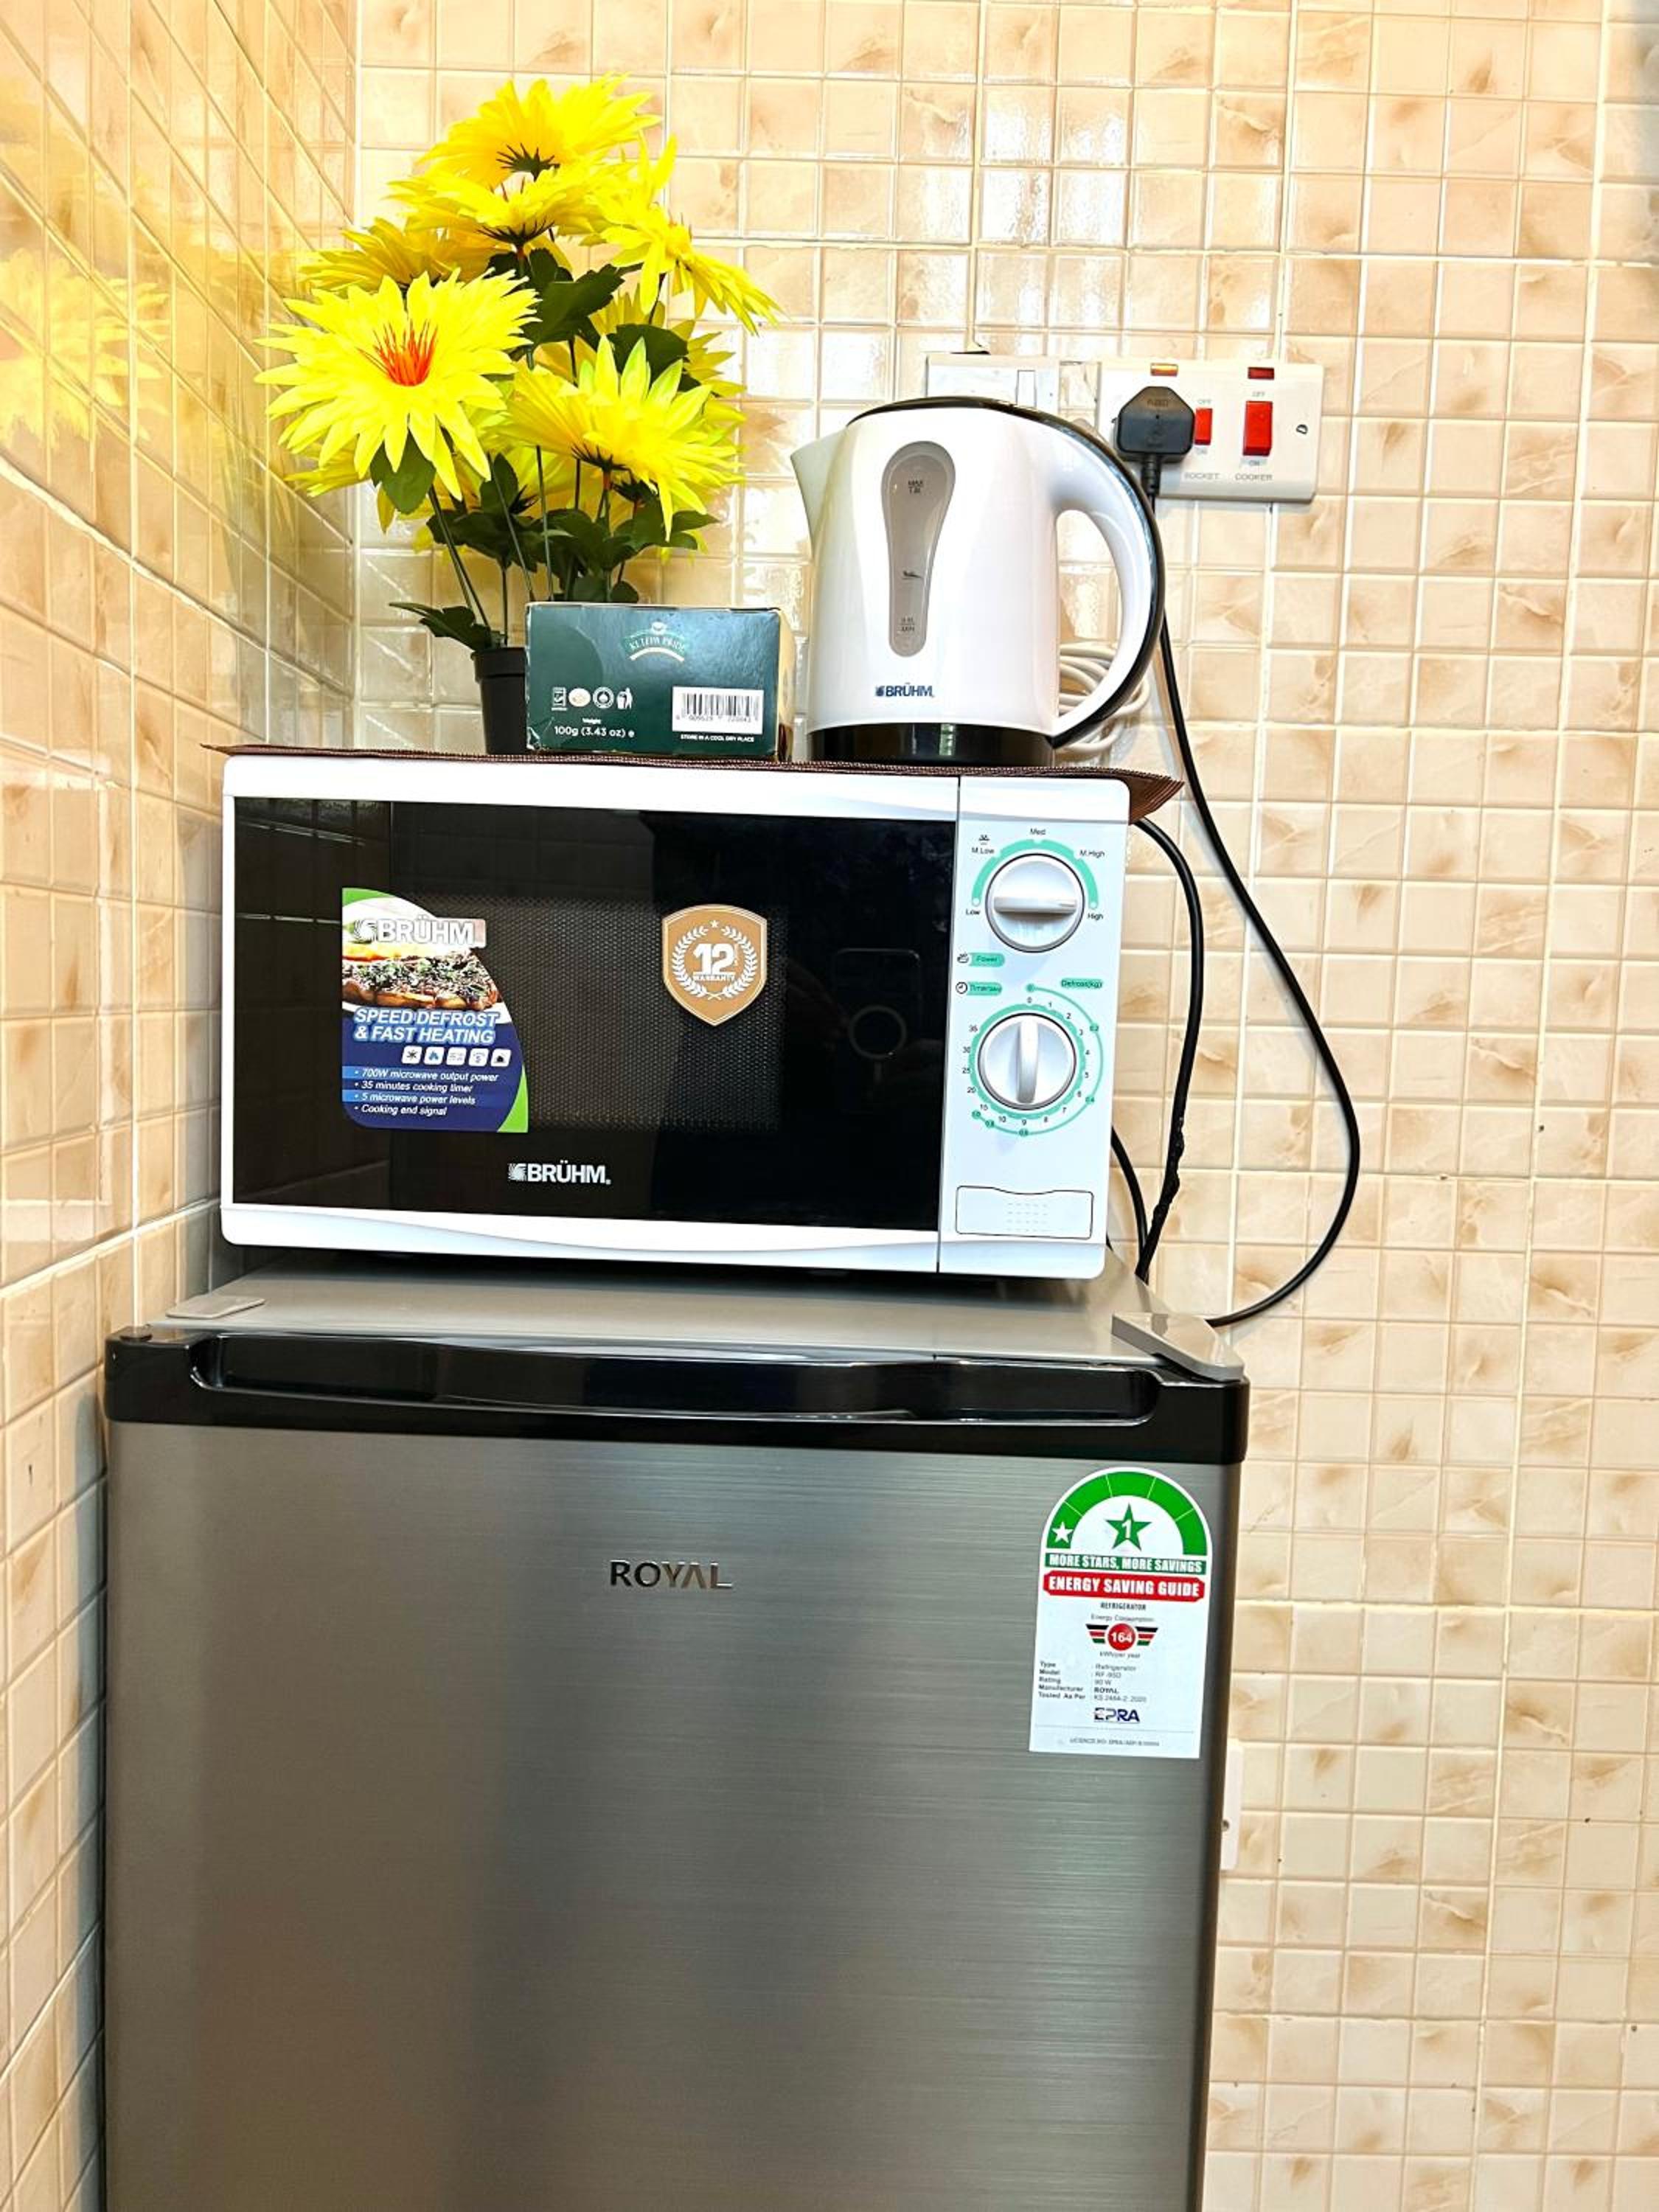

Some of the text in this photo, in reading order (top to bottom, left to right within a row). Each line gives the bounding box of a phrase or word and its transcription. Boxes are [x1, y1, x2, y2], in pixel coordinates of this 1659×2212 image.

[1234, 472, 1273, 481] COOKER
[554, 725, 579, 737] 100g
[581, 726, 607, 737] (3.43
[609, 728, 626, 738] oz)
[1087, 912, 1104, 920] High
[693, 943, 736, 975] 12
[354, 1008, 499, 1026] SPEED DEFROST
[354, 1026, 495, 1043] & FAST HEATING
[361, 1068, 498, 1082] 700W microwave output power
[361, 1080, 473, 1093] 35 minutes cooking timer
[369, 1093, 417, 1102] microwave
[420, 1096, 448, 1104] power
[449, 1095, 476, 1105] levels
[361, 1104, 448, 1117] Cooking and signal
[1121, 1519, 1132, 1540] 1
[1049, 1554, 1202, 1573] MORE STARS, MORE SAVINGS
[610, 1559, 734, 1590] ROYAL
[1048, 1576, 1200, 1597] ENERGY SAVING GUIDE
[1100, 1601, 1147, 1611] REFRIGERATOR
[1091, 1613, 1113, 1621] Energy
[1110, 1632, 1133, 1644] 164
[1039, 1677, 1061, 1685] Rating
[1038, 1691, 1061, 1699] Tested
[1094, 1686, 1119, 1694] ROYAL
[1093, 1707, 1141, 1722] EPRA
